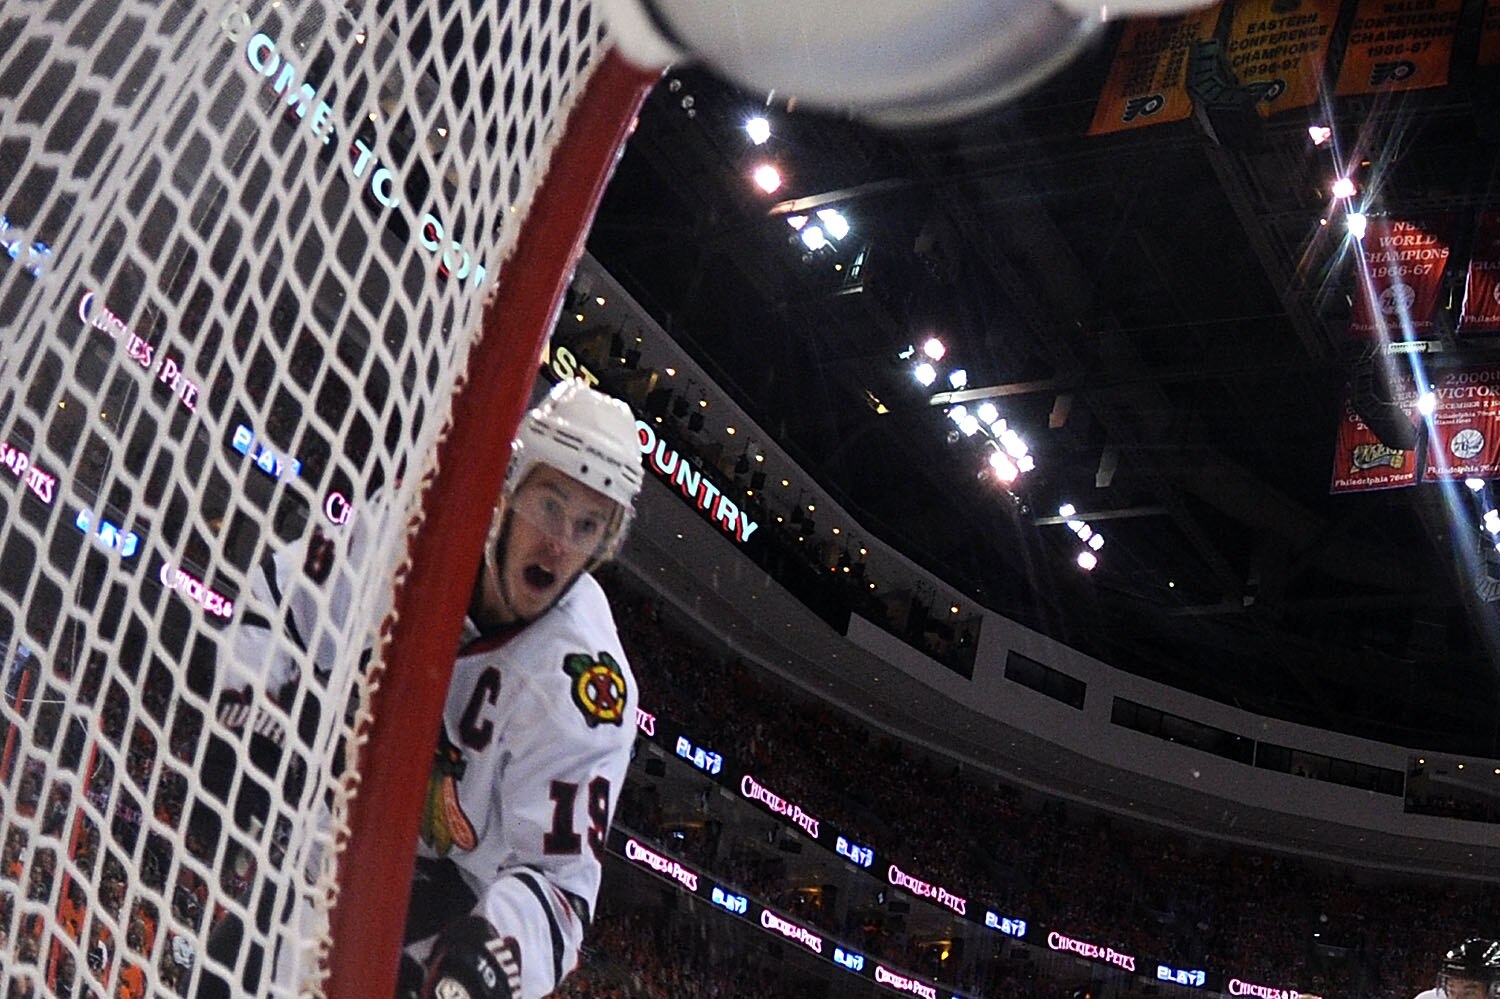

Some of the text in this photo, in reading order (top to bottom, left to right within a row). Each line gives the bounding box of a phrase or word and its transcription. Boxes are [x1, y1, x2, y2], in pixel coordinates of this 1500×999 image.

[1247, 13, 1318, 34] EASTERN
[1230, 25, 1327, 52] CONFERENCE
[1232, 40, 1319, 67] CHAMPIONS
[1379, 234, 1438, 247] WORLD
[1364, 247, 1450, 263] CHAMPIONS
[350, 139, 758, 543] TO OUNTRY
[1335, 475, 1388, 488] Philadelphia
[459, 666, 501, 753] C
